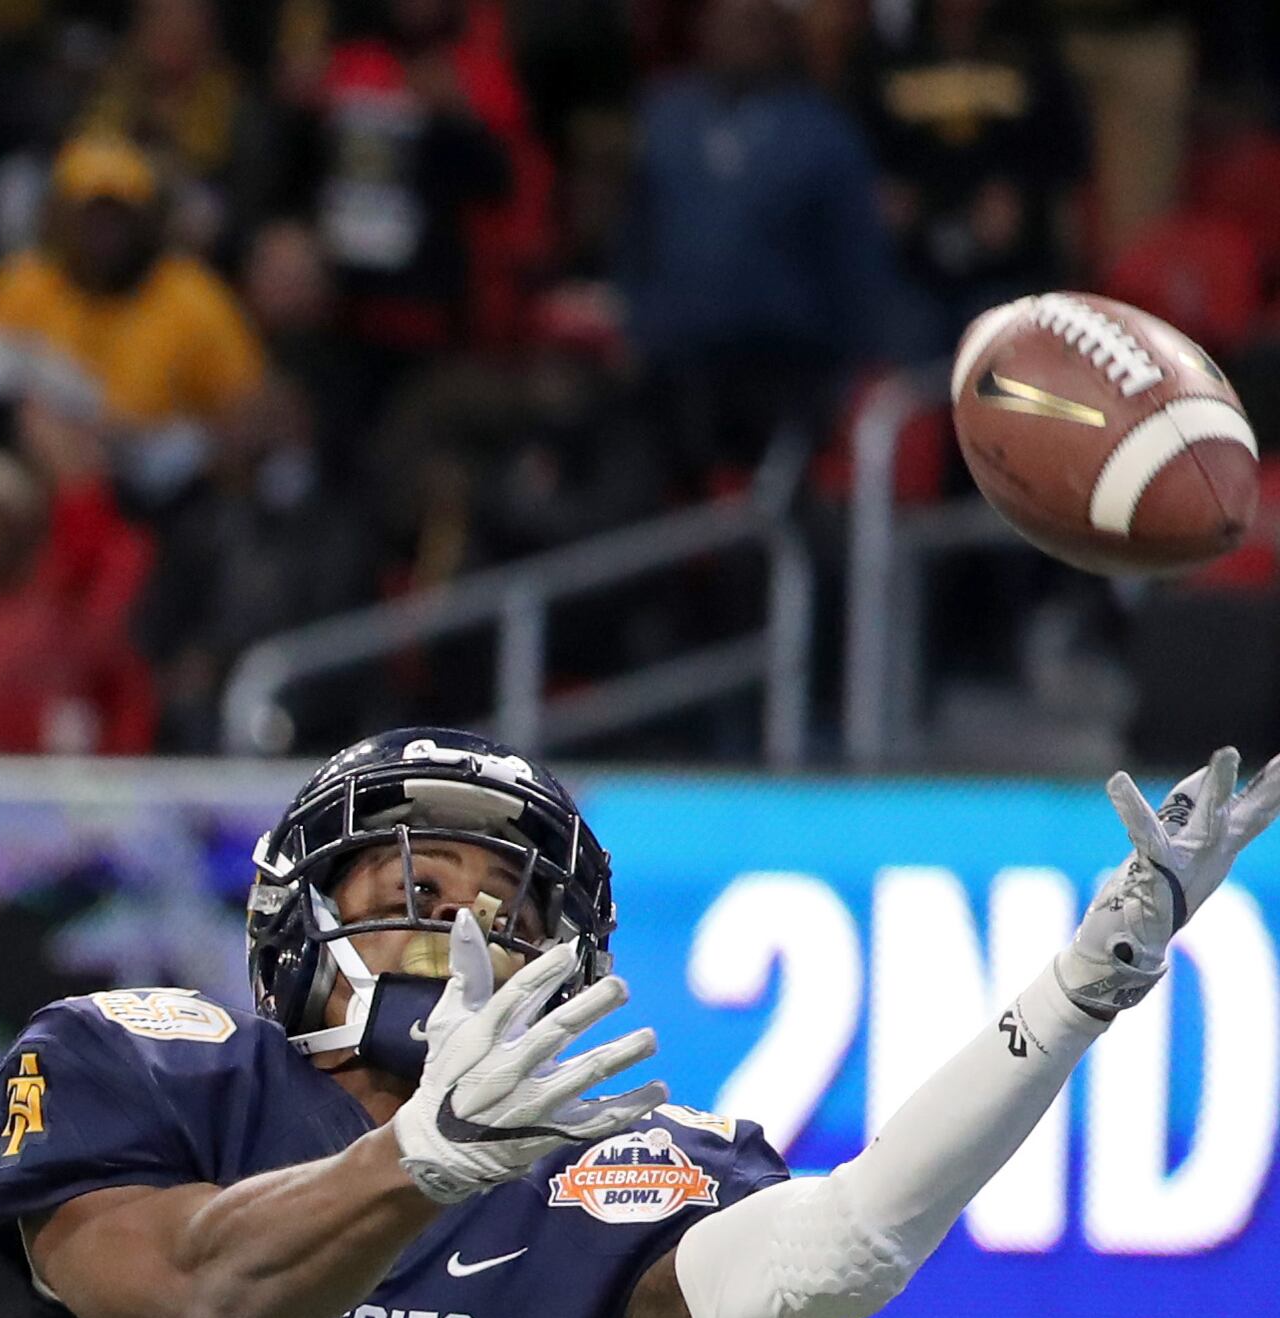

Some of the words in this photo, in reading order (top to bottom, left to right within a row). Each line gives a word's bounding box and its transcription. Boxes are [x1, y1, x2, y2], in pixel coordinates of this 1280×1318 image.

[688, 866, 1278, 1254] 2ND
[574, 1170, 693, 1185] CELEBRATION
[604, 1189, 663, 1204] BOWL
